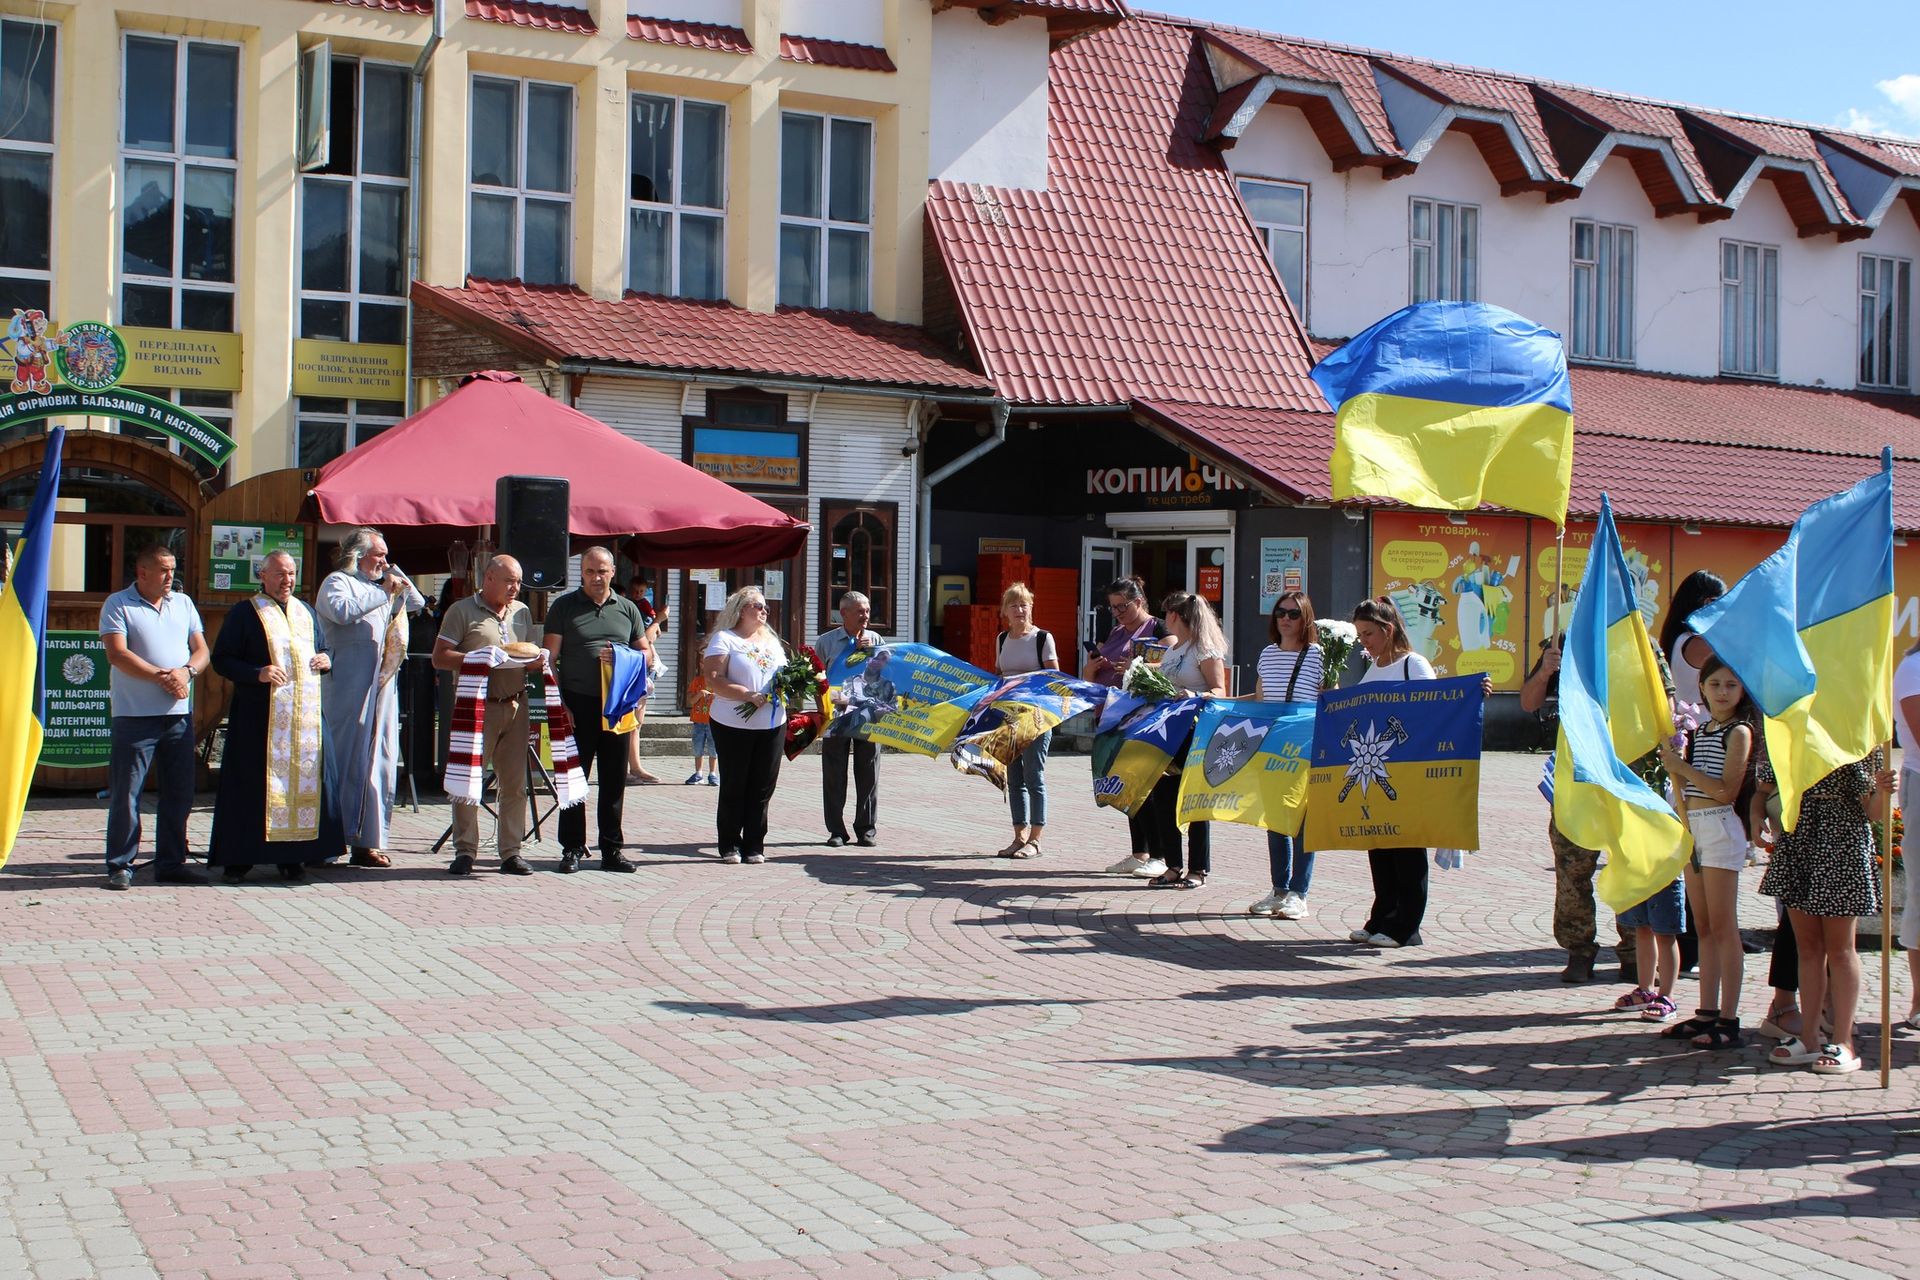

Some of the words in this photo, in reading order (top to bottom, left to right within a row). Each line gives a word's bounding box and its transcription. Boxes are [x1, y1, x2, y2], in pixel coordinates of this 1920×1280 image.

[139, 340, 216, 352] ПЕРЕДПЛАТА
[135, 352, 221, 365] ПЕРІОДИЧНИХ
[321, 354, 388, 366] ВІДПРАВЛЕННЯ
[154, 365, 202, 375] ВИДАНЬ
[67, 371, 117, 389] ЧАР-ЗІЛЛЯ
[317, 375, 353, 384] ЦІННИХ
[358, 377, 391, 386] ЛИСТІВ
[17, 395, 77, 411] ФІРМОВИХ
[82, 395, 145, 414] БАЛЬЗАМІВ
[150, 407, 161, 420] ТА
[164, 413, 222, 453] НАСТОЯНОК
[1147, 496, 1158, 505] те
[1161, 496, 1177, 506] що
[1180, 493, 1211, 505] треба
[1418, 525, 1436, 537] тут
[1572, 532, 1588, 543] тут
[1492, 639, 1517, 653] -45%
[903, 652, 940, 669] ШАТРУК
[912, 669, 970, 694] ВАСИЛЬОВИЧ
[1410, 688, 1465, 702] БРИГАДА
[51, 701, 105, 710] МОЛЬФАРІВ
[50, 717, 105, 726] АВТЕНТИЧНІ
[1281, 742, 1301, 757] НА
[1437, 741, 1455, 752] НА
[1264, 757, 1299, 773] ЩИТІ
[1425, 767, 1463, 779] ЩИТІ
[1340, 822, 1400, 837] ЕДЕЛЬВЕЙС
